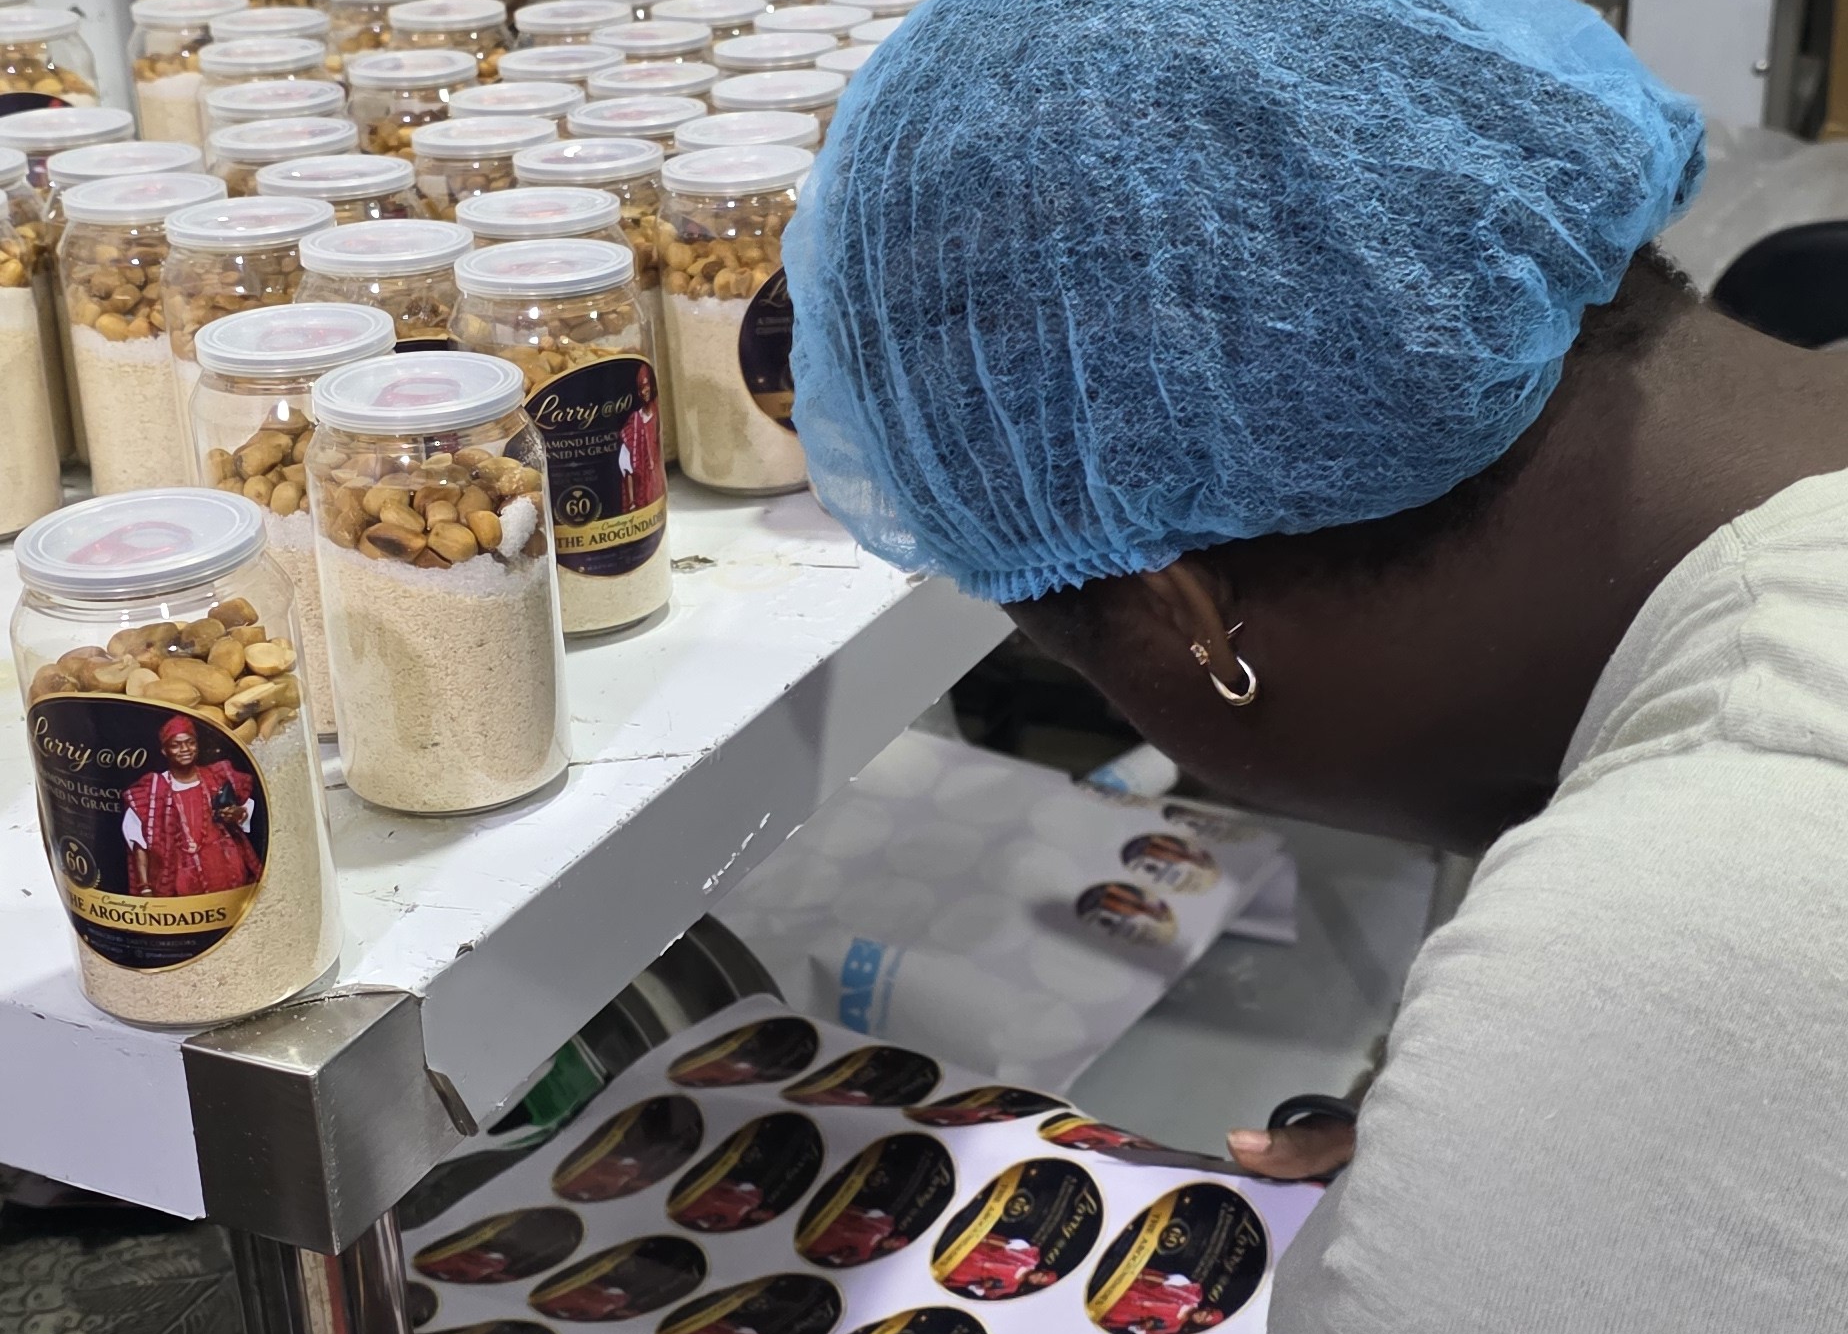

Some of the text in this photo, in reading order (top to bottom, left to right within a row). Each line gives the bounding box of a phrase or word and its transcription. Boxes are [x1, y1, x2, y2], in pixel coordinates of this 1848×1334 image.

[534, 394, 600, 430] Larry
[546, 438, 583, 450] AMOND
[565, 497, 591, 517] 60
[556, 535, 585, 549] THE
[33, 716, 92, 772] Larry
[76, 782, 122, 800] LEGACY
[80, 796, 121, 813] GRACE
[65, 850, 88, 876] 60
[89, 903, 228, 927] AROGUNDADES
